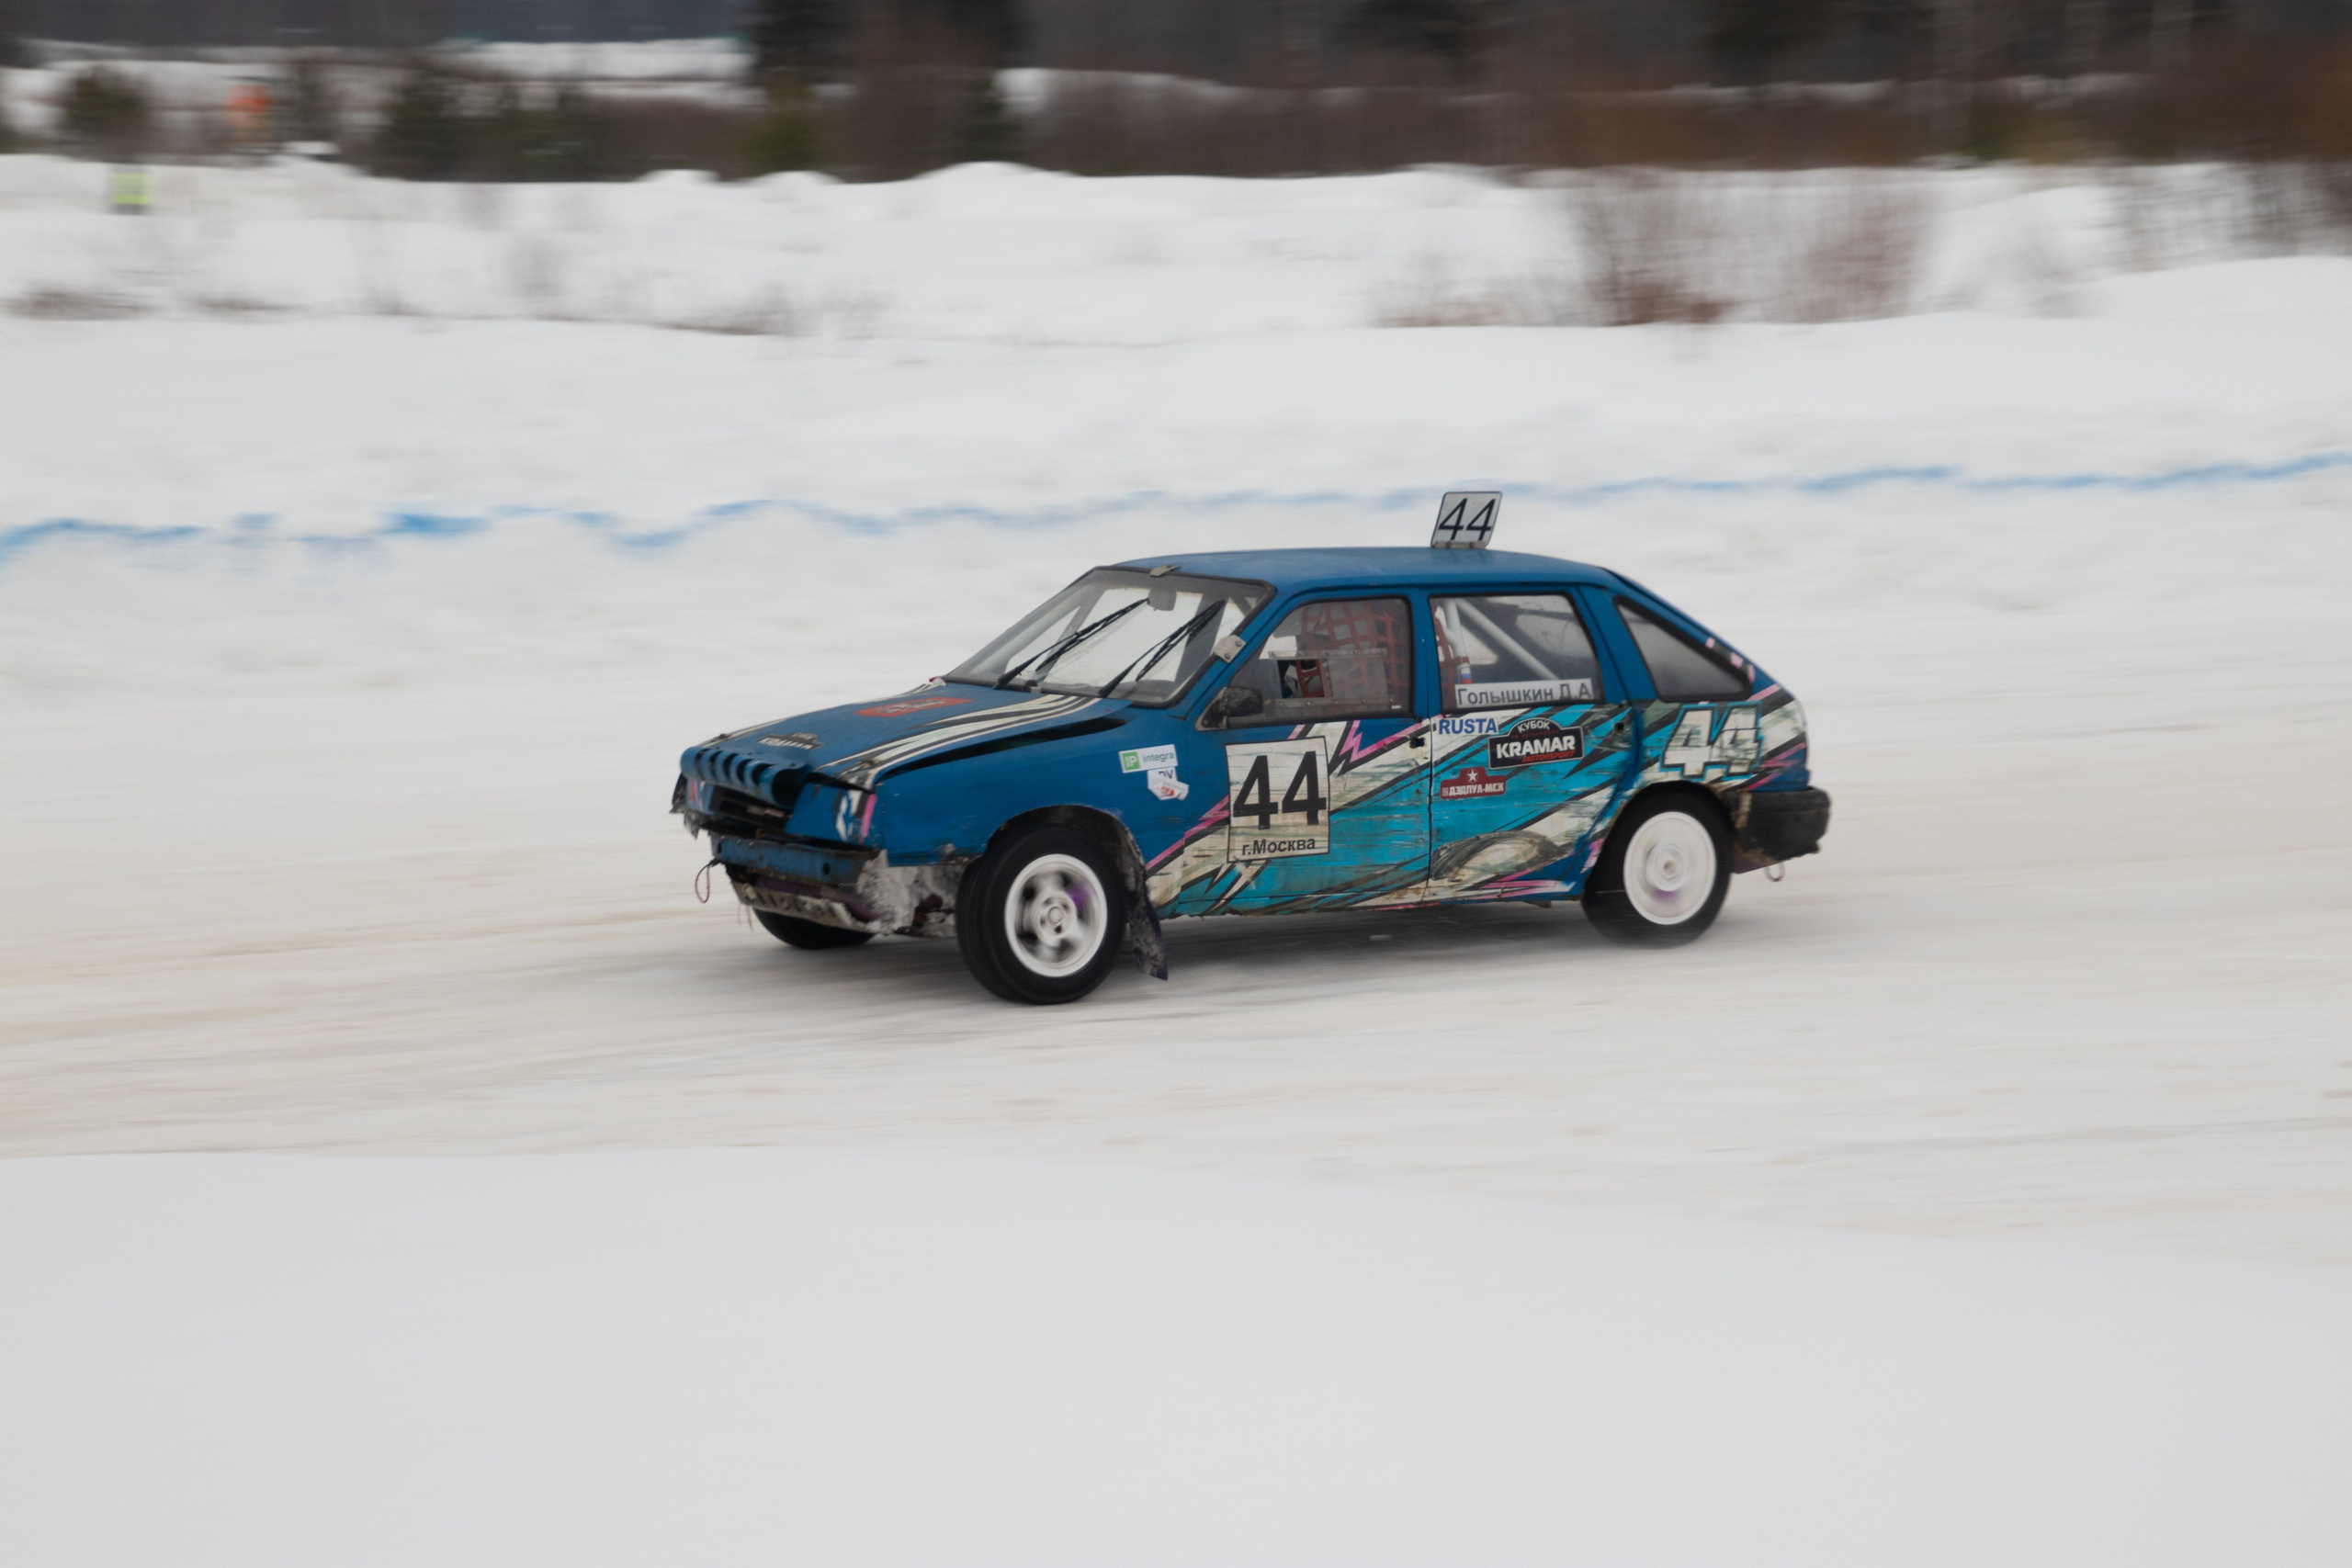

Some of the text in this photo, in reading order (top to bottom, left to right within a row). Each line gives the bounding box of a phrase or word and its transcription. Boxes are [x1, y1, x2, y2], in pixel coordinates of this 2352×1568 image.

[1438, 497, 1496, 541] 44
[1457, 687, 1554, 705] Голышкин
[1438, 717, 1498, 735] RUSTA
[1517, 720, 1551, 733] КУБОК
[1496, 735, 1576, 759] KRAMAR
[1660, 702, 1762, 780] 44
[1142, 751, 1175, 763] integra
[1521, 750, 1576, 763] MOTORSPORT
[1233, 750, 1327, 830] 44
[1241, 837, 1317, 856] г.Москва
